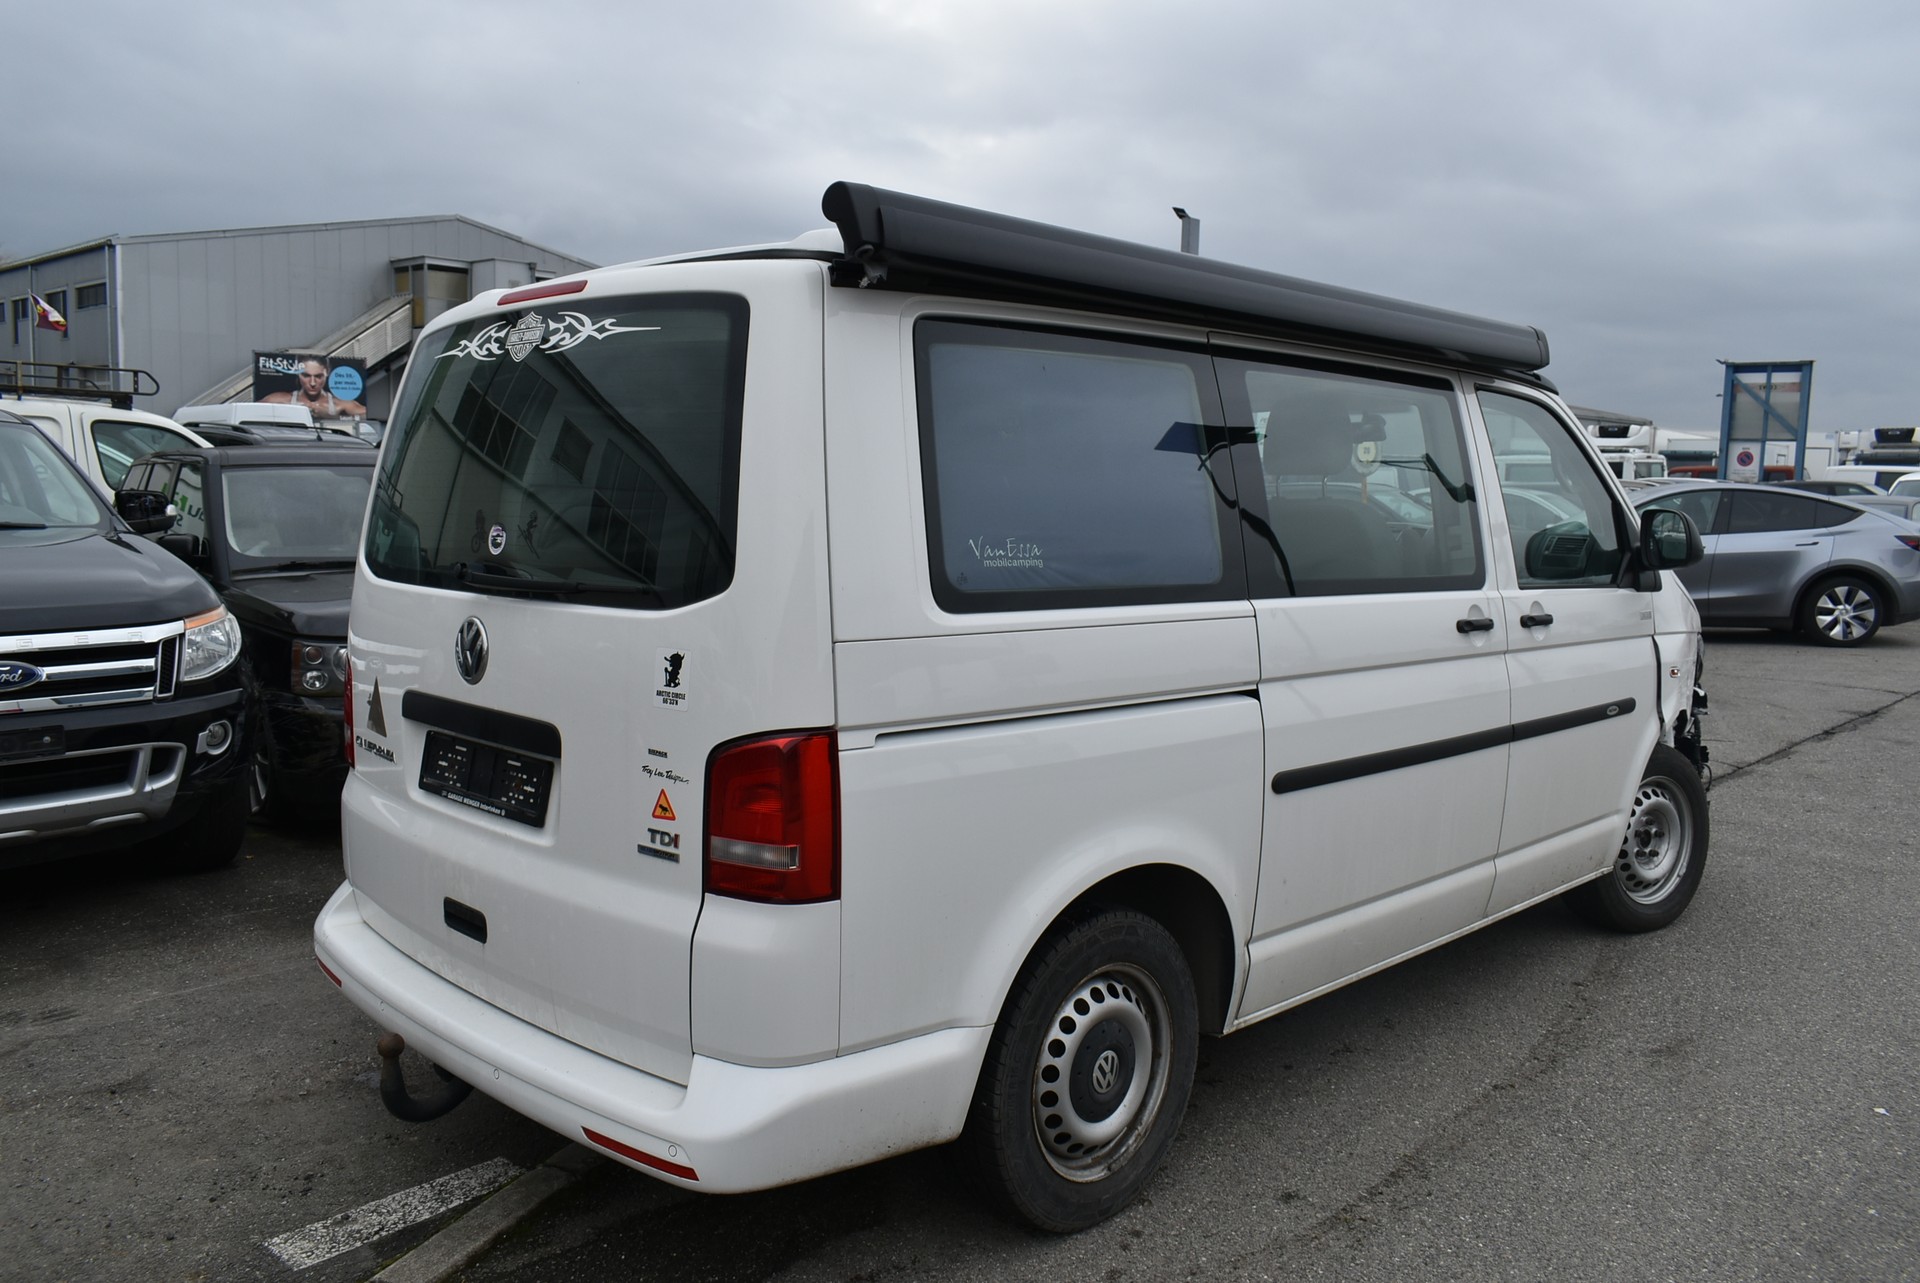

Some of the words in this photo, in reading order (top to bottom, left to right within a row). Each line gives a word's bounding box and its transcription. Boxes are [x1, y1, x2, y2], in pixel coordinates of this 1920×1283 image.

[259, 356, 305, 371] Fit-Style
[968, 536, 1043, 559] VanEssa
[983, 558, 1044, 569] mobilcamping
[656, 690, 671, 698] ARCTIC
[671, 692, 686, 700] CIRCLE
[641, 765, 654, 778] Troy
[654, 768, 665, 778] Lee
[447, 792, 463, 803] GARAGE
[463, 797, 480, 808] WENGER
[647, 827, 680, 850] TDI
